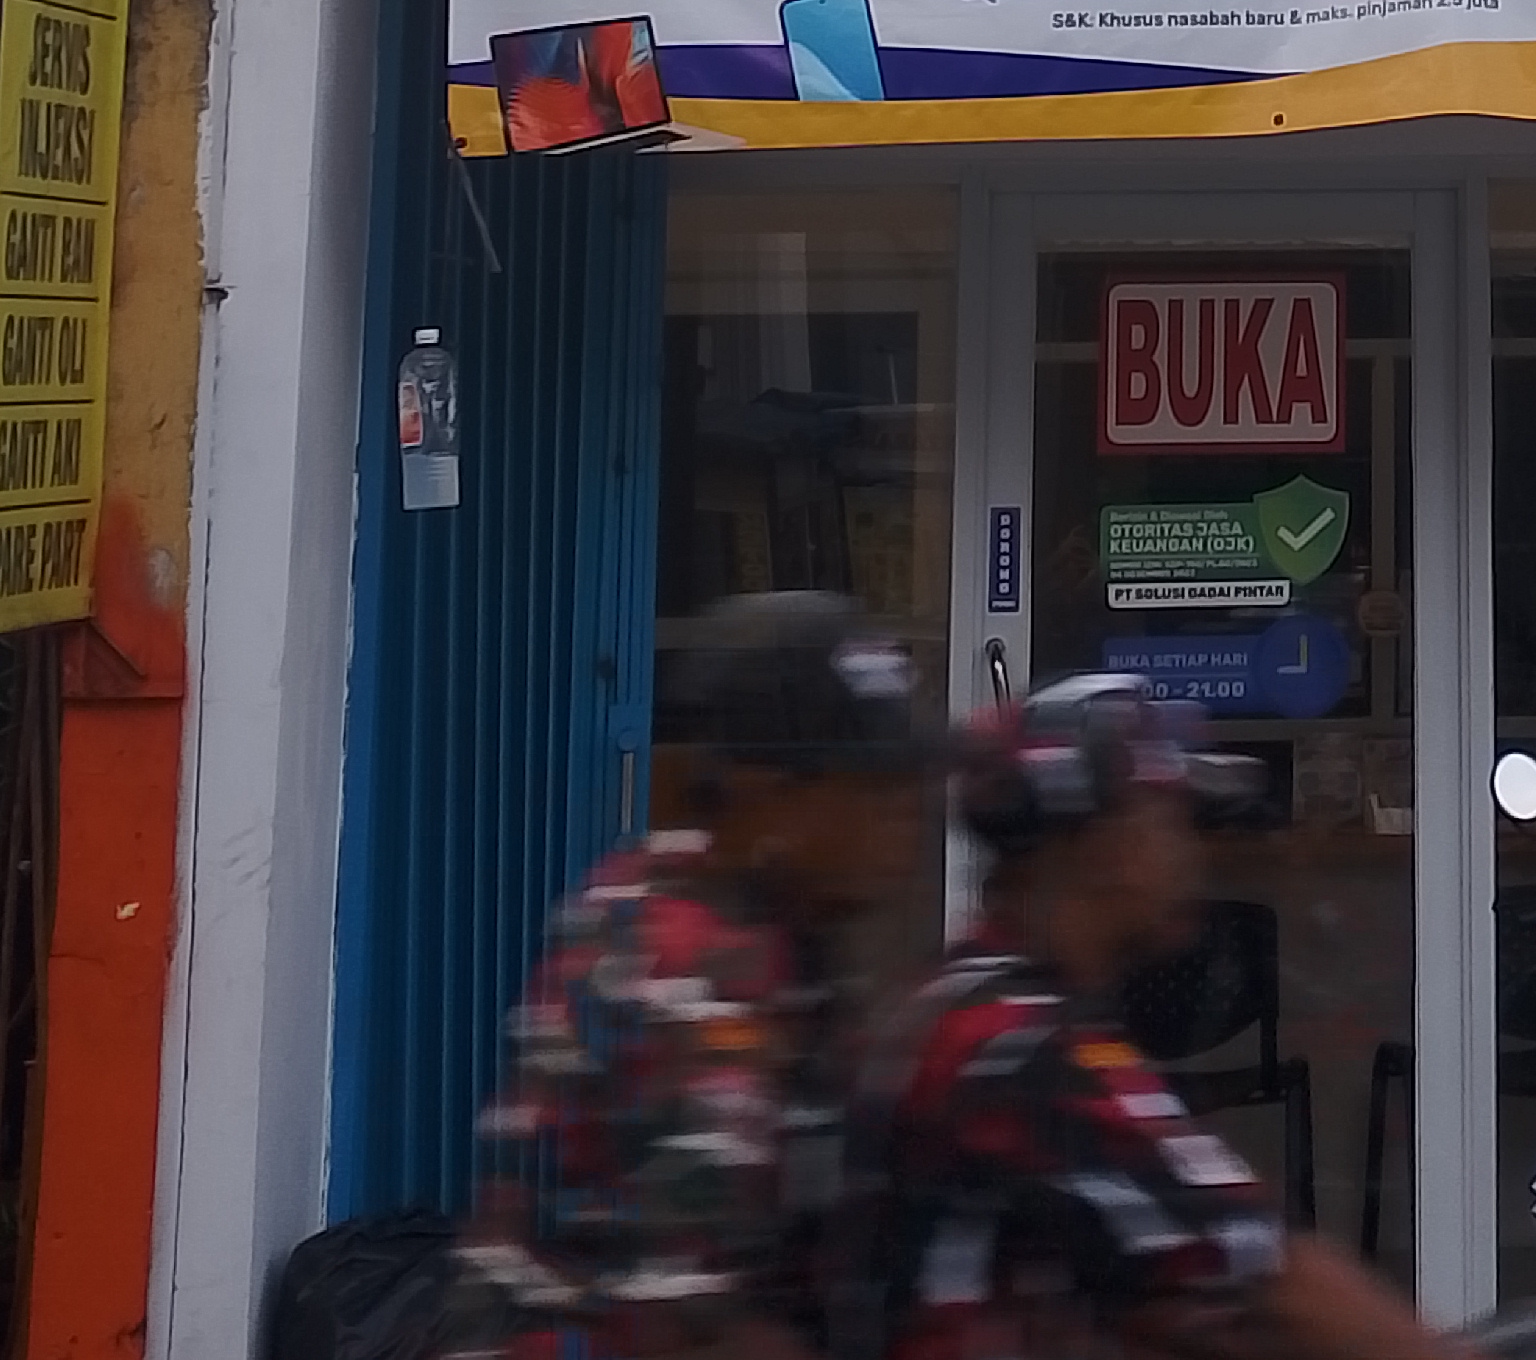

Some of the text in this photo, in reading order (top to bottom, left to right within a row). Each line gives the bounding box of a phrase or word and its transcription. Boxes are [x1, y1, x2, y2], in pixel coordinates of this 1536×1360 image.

[1098, 12, 1164, 28] Khusus
[1167, 10, 1242, 27] nasabah
[1245, 9, 1285, 26] baru
[18, 97, 96, 186] INJEKSI
[5, 208, 58, 284] GANTI
[2, 313, 88, 386] GANTI OLI
[1115, 297, 1328, 427] BUKA
[1110, 522, 1243, 538] OTORITAS JASA
[1110, 535, 1255, 554] KEUANGAN (OJK)
[38, 518, 87, 591] PART
[1115, 585, 1284, 601] PT SOLUSI GADAI PINTAR
[1109, 652, 1248, 668] BUKA SETIAP HARI
[1187, 682, 1245, 698] 21.00
